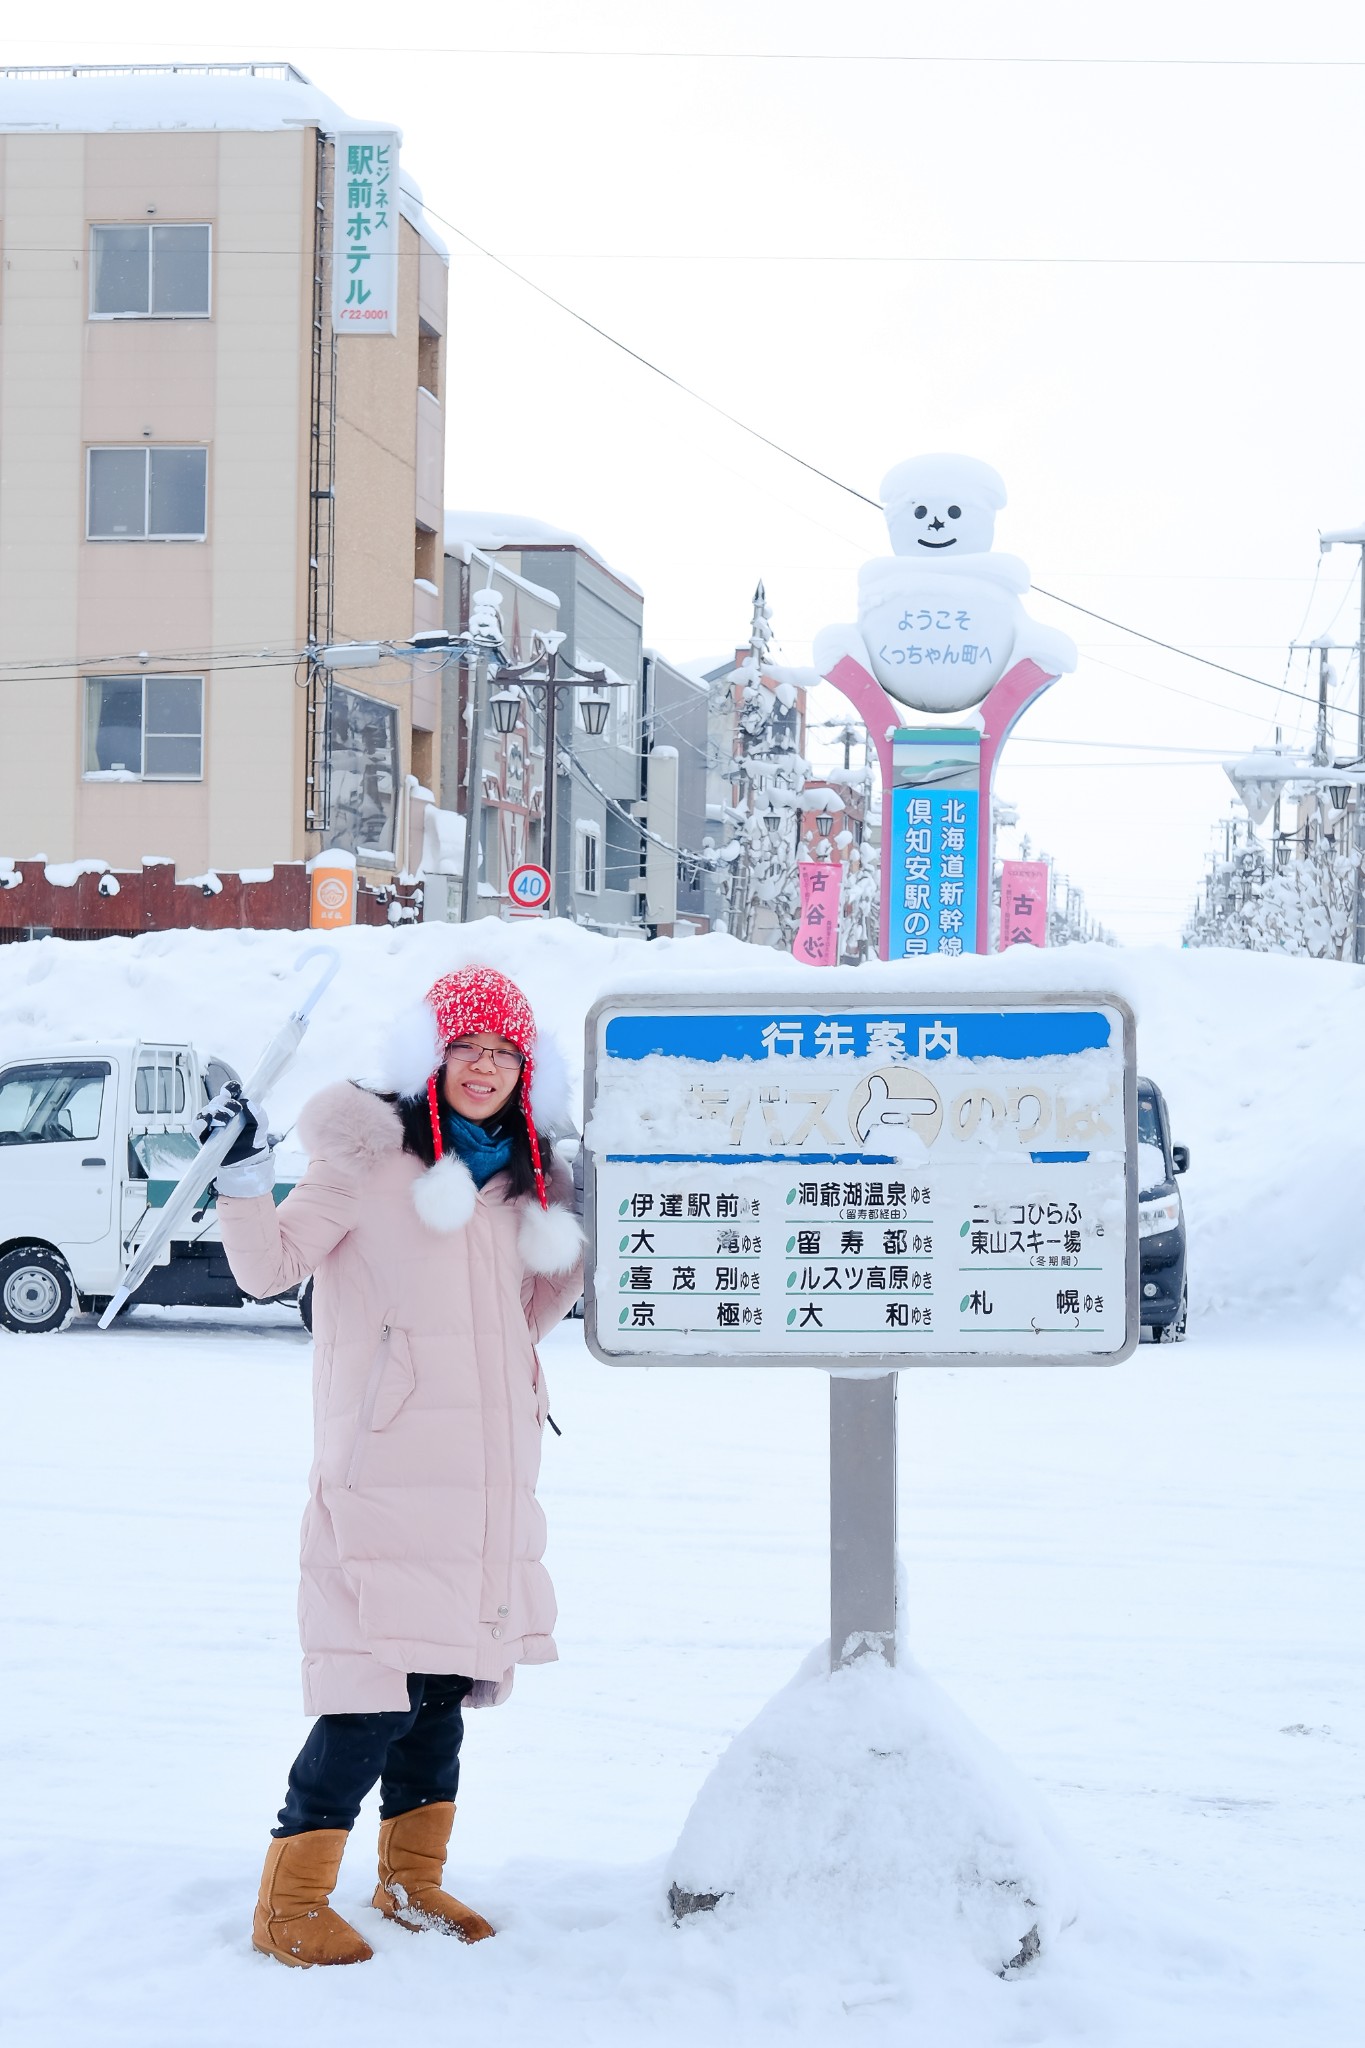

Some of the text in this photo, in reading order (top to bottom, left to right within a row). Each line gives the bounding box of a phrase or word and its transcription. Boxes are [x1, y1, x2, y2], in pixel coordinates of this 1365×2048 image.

[375, 145, 391, 230] ビジネス
[345, 145, 373, 305] 駅前ホテル
[348, 309, 388, 320] 22-0001
[898, 609, 971, 631] ようこそ
[879, 644, 992, 665] くっちゃん町へ
[517, 876, 542, 896] 40
[938, 799, 966, 957] 北海道新幹線
[761, 1020, 958, 1058] 行先案内
[970, 1229, 1082, 1254] 東山スキー場
